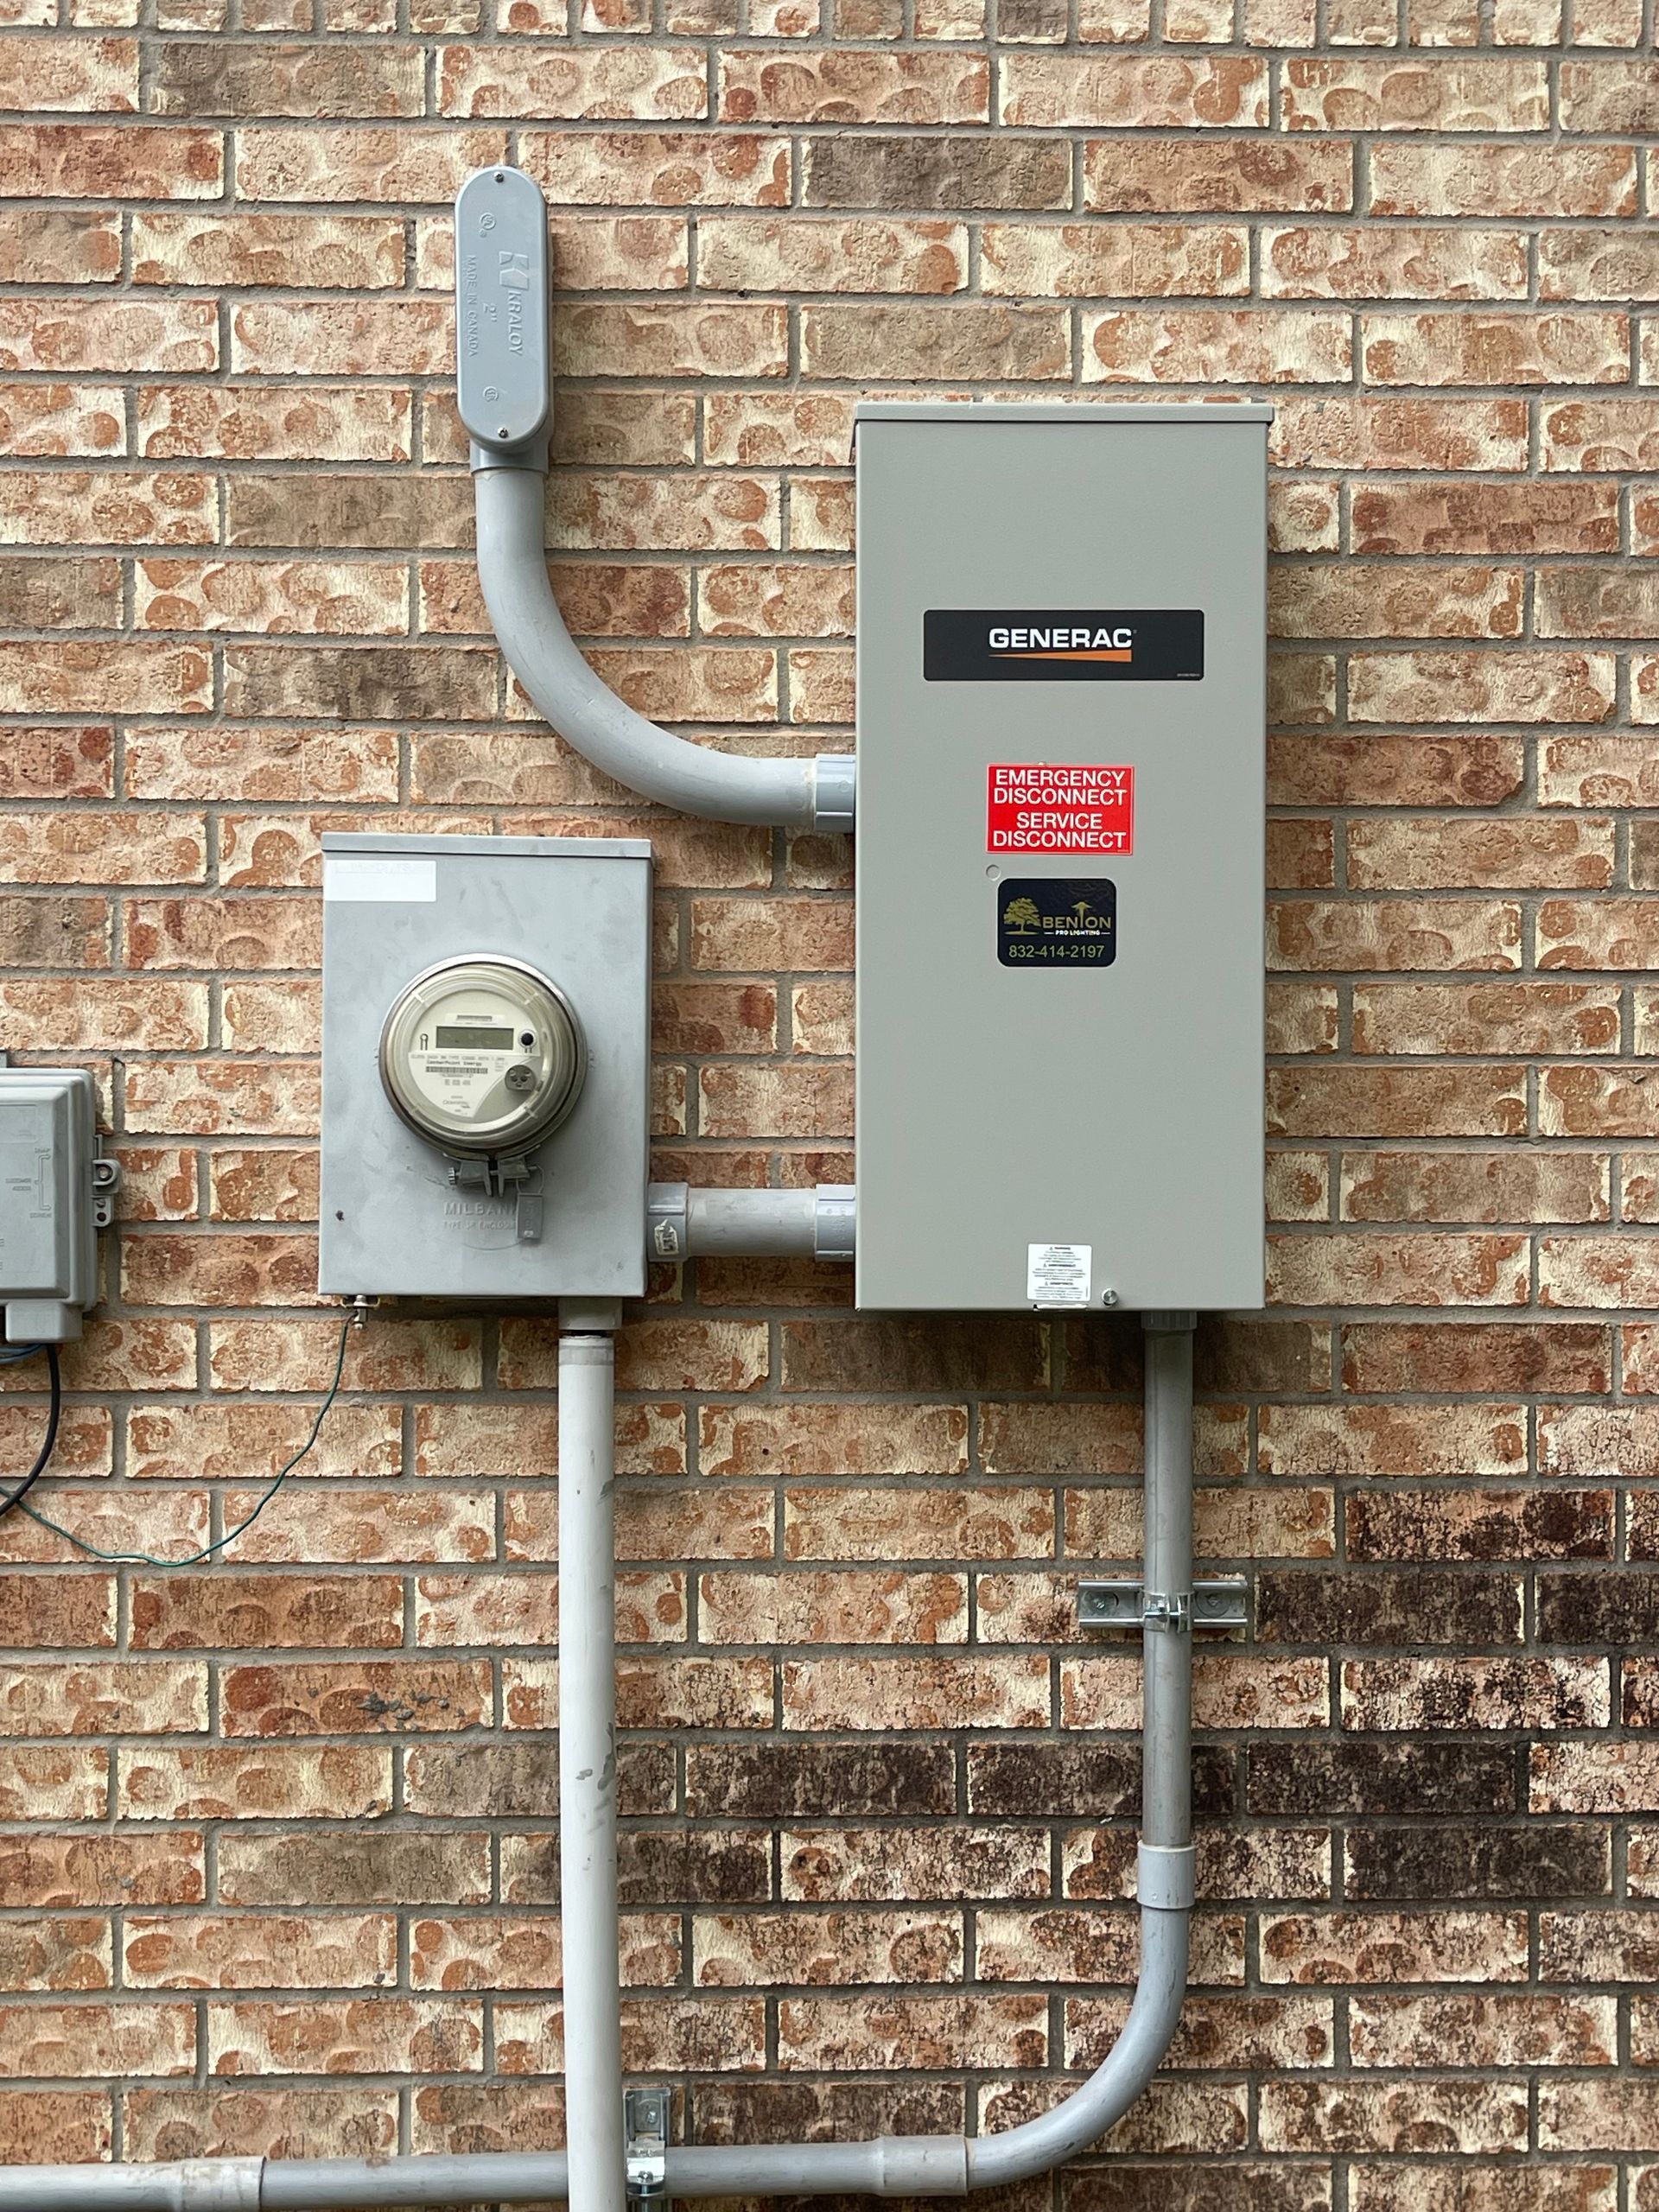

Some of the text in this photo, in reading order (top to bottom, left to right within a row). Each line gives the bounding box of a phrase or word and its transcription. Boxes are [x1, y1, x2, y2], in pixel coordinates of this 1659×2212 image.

[467, 255, 479, 358] MADE IN CANADA
[507, 291, 523, 356] KRALOY
[988, 628, 1133, 649] GENERAC
[995, 769, 1125, 787] EMERGENCY
[994, 788, 1127, 805] DISCONNECT
[1016, 812, 1103, 830] SERVICE
[993, 830, 1127, 848] DISCONNECT
[1008, 945, 1105, 958] 832-414-2197
